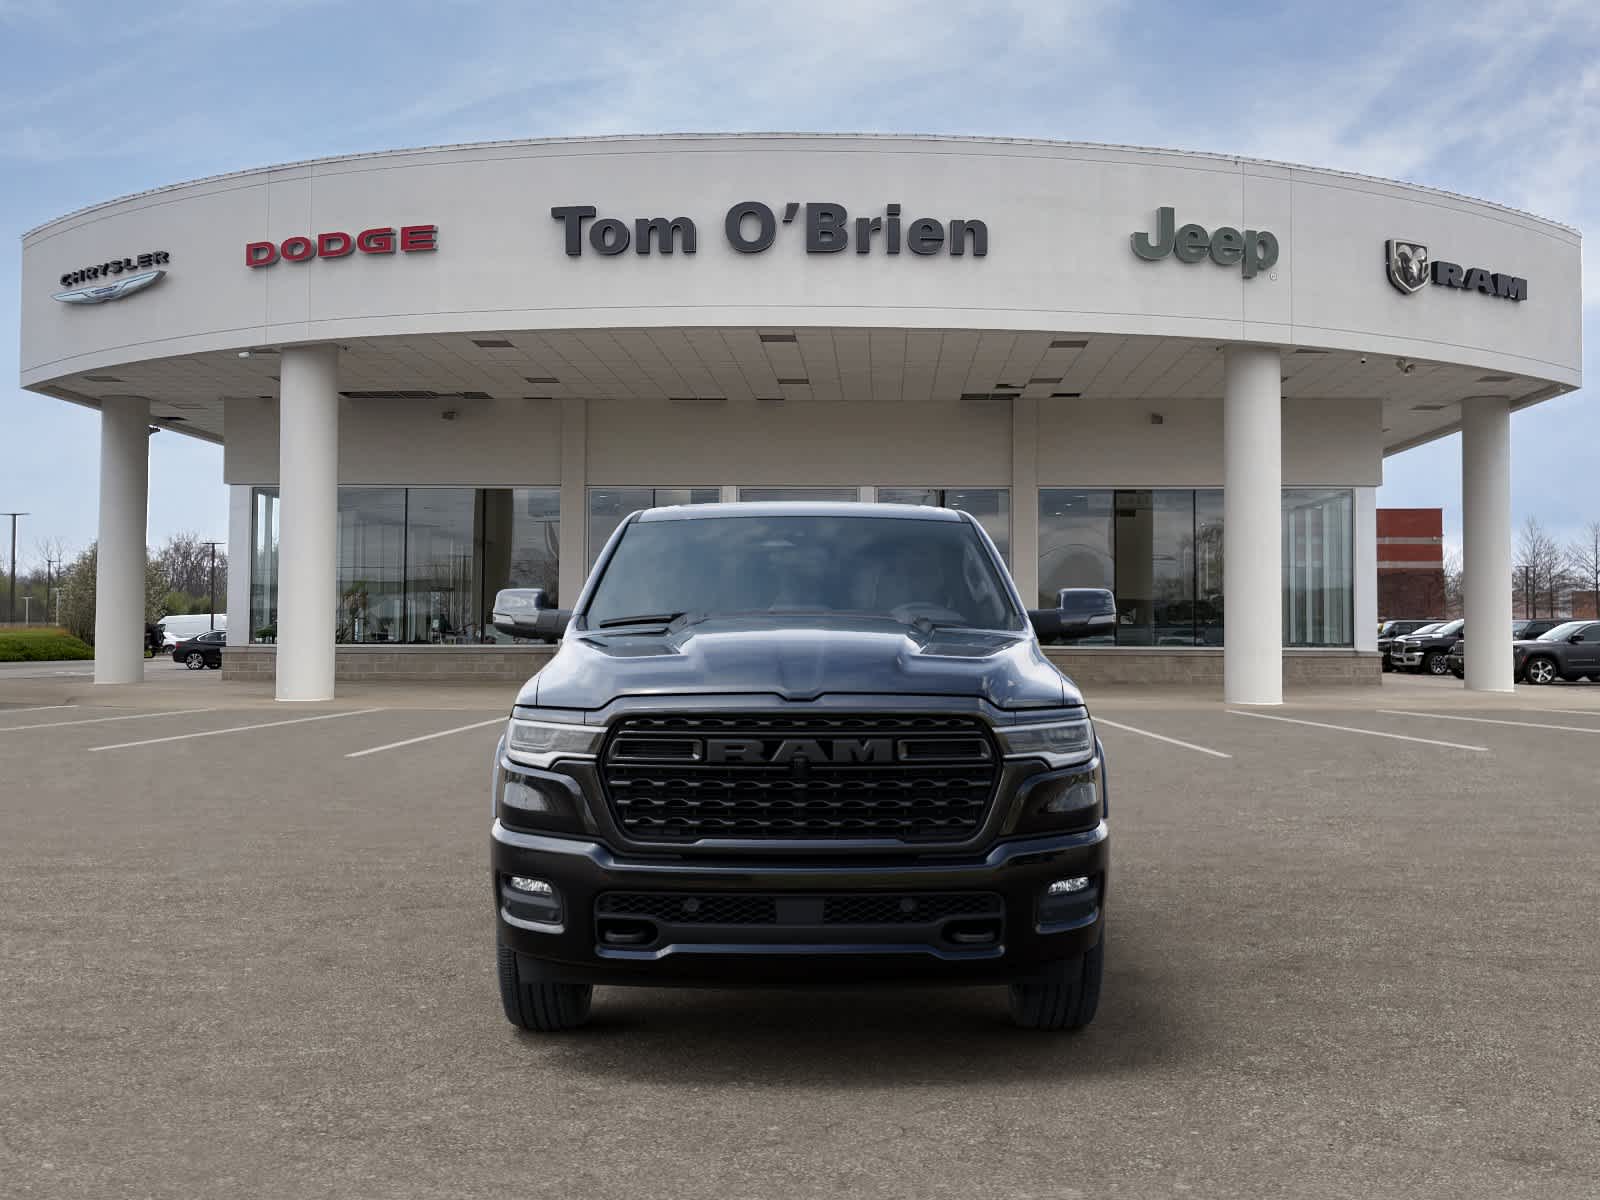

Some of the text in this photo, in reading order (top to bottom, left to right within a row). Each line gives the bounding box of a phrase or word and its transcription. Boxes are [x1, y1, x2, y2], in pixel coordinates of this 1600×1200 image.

[245, 225, 438, 268] DODGE
[551, 201, 989, 257] Tom O'Brien
[1130, 206, 1279, 279] Jeep
[60, 251, 170, 287] CHRYSLER
[1430, 261, 1528, 301] RAM
[706, 738, 894, 762] RAM
